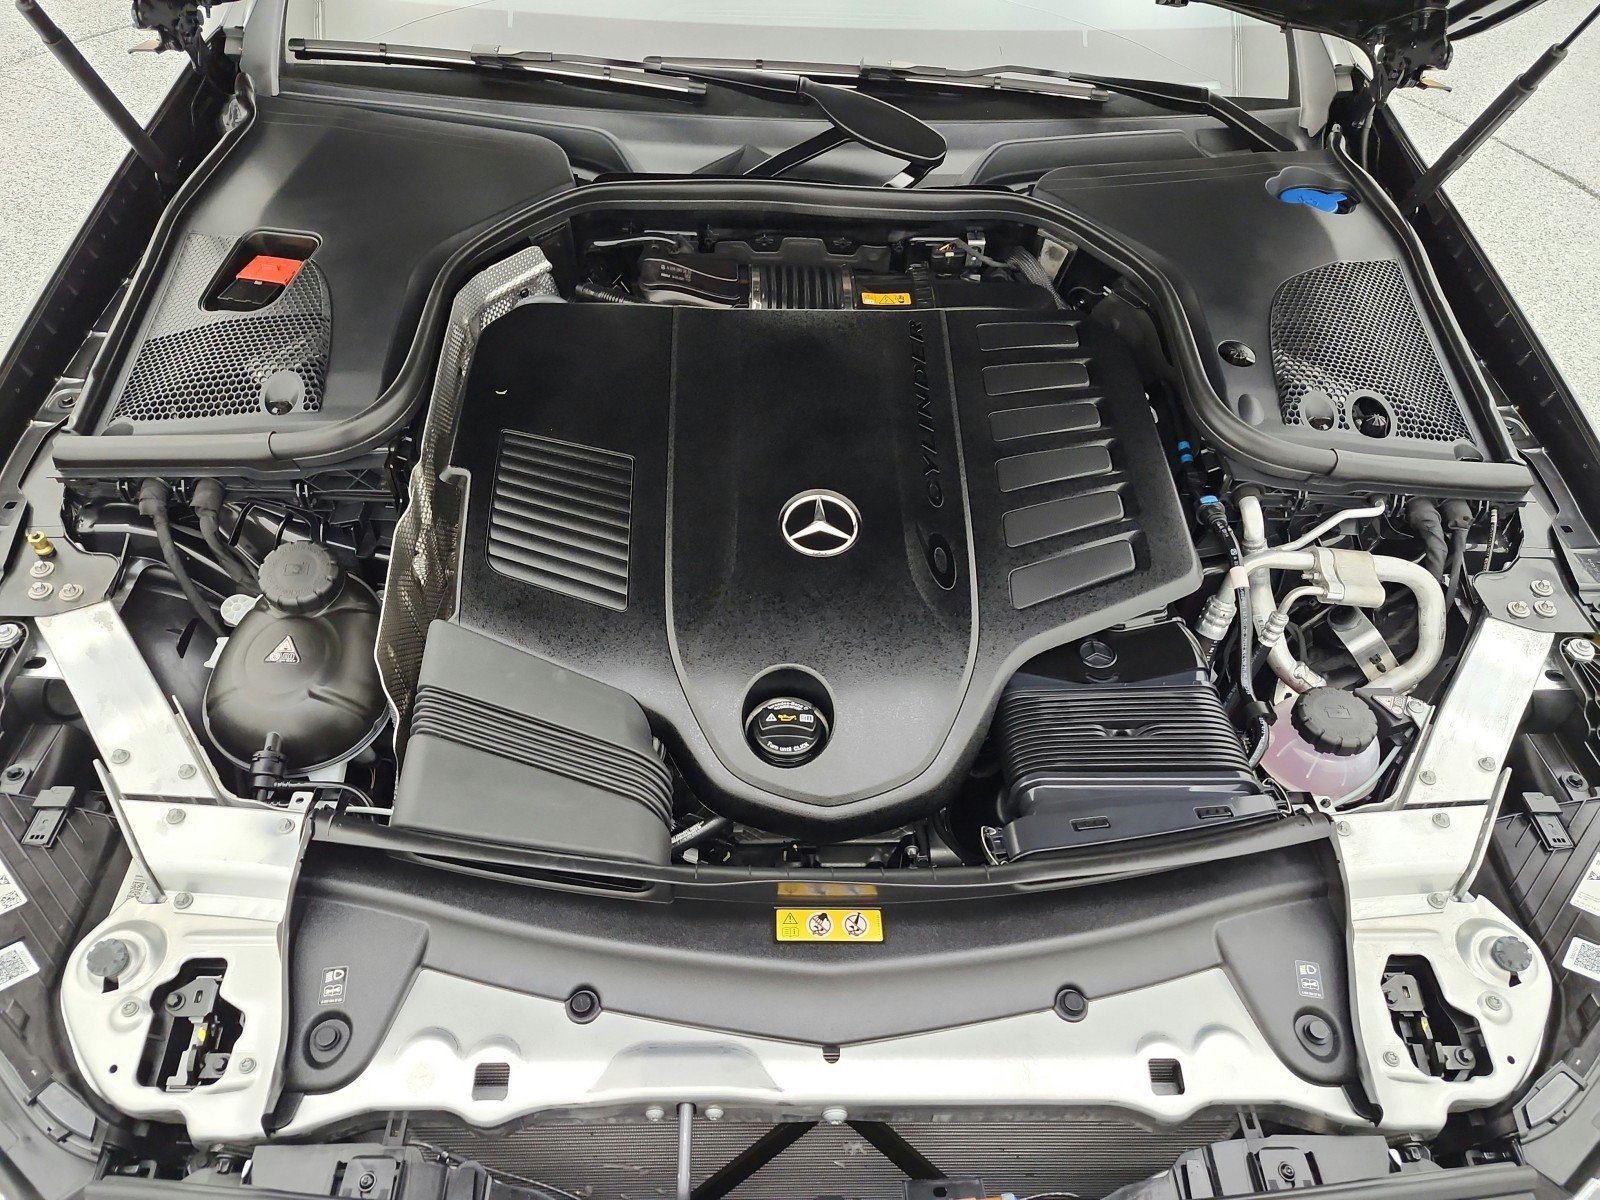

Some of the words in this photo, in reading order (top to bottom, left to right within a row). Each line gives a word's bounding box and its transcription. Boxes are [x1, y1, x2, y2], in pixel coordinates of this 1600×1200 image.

[908, 319, 944, 508] CYLINDER
[915, 522, 957, 590] 6
[767, 741, 779, 751] Turn
[793, 741, 810, 752] CLICK
